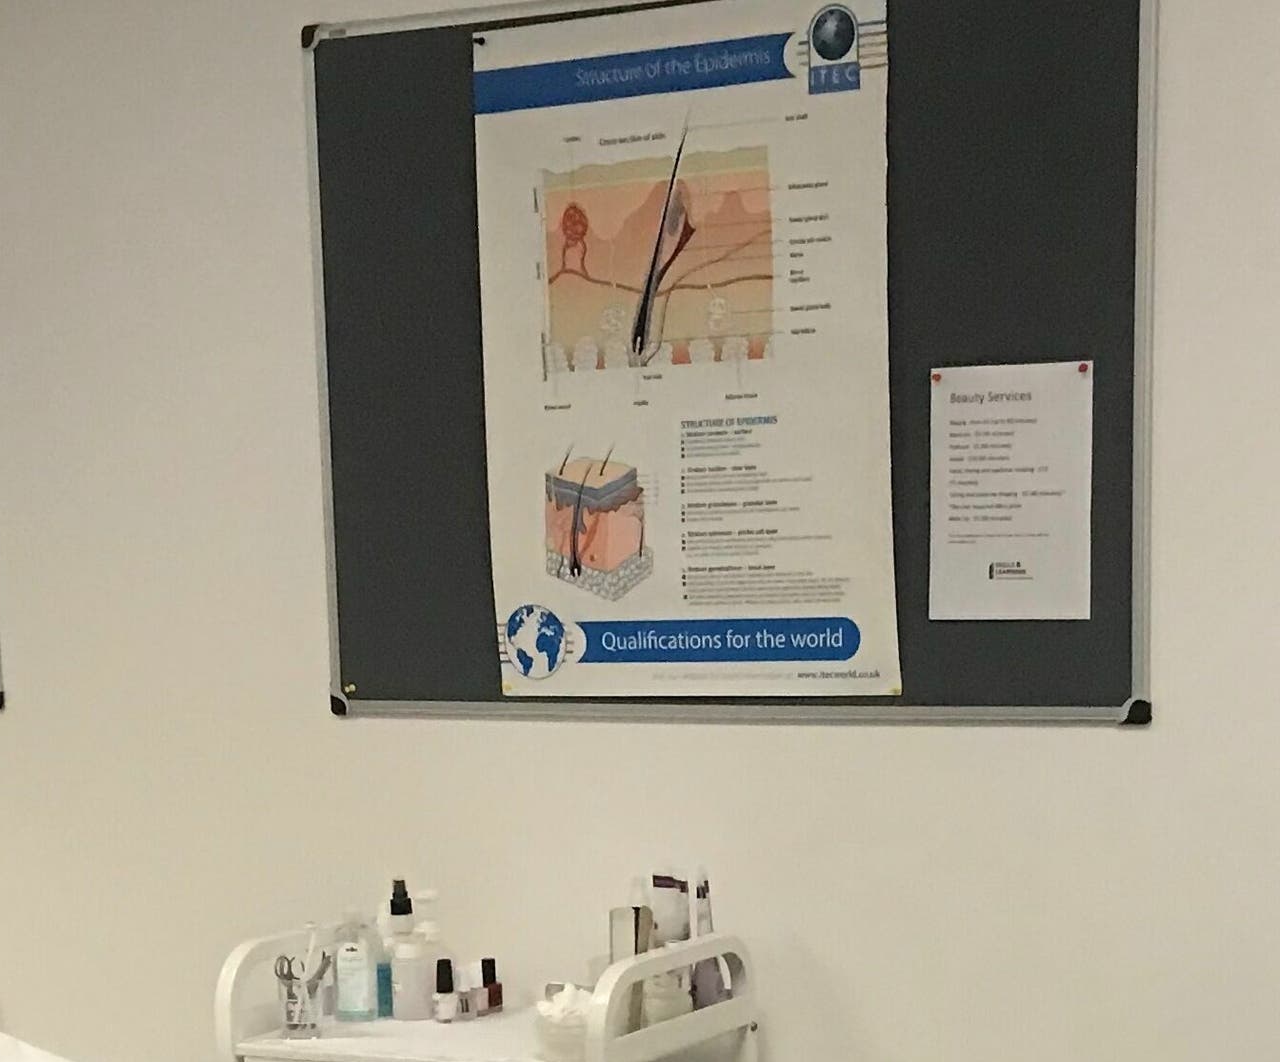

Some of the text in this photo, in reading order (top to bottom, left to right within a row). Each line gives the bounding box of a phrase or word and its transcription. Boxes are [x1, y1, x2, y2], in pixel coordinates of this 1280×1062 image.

[576, 67, 642, 86] Structure
[665, 58, 692, 75] the
[696, 50, 770, 74] Epidermis
[811, 65, 858, 85] ITEC
[950, 391, 1032, 404] Beauty Services
[602, 627, 843, 652] Qualifications for the world
